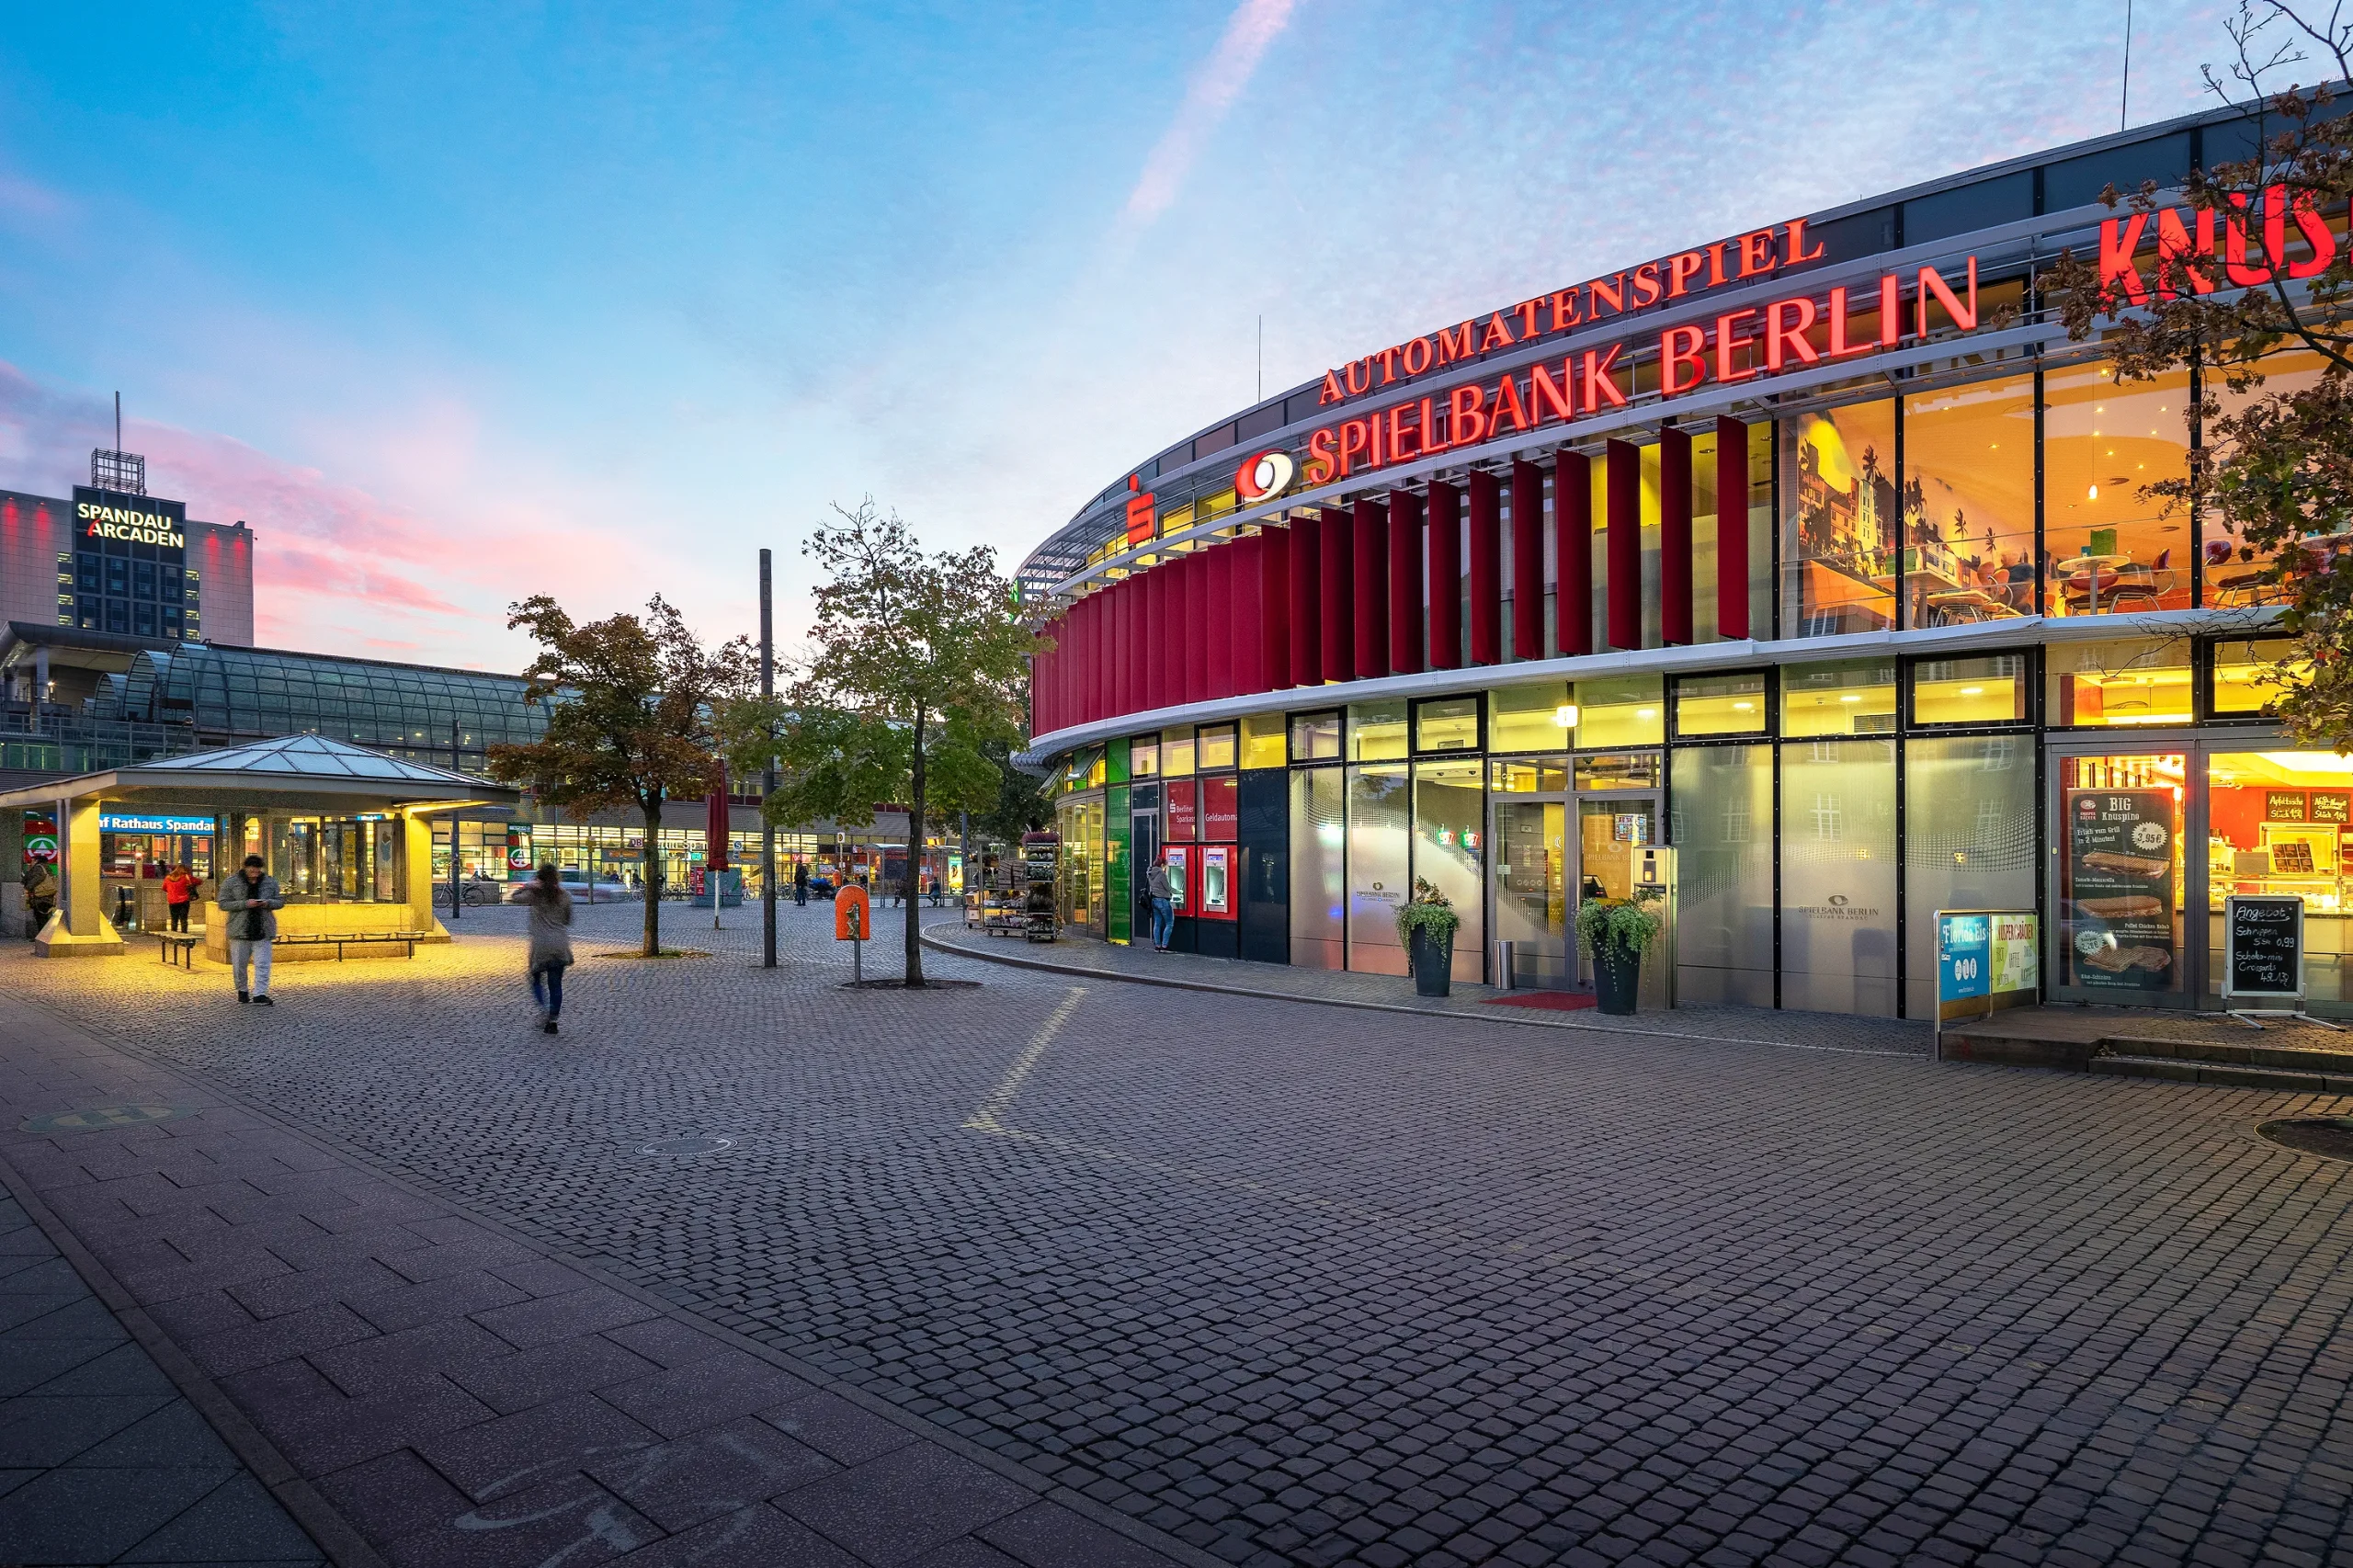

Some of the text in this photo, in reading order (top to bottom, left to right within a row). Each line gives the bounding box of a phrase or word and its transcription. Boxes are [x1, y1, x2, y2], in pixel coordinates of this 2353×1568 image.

[1318, 218, 1826, 407] AUTOMATENSPIEL
[1308, 255, 1979, 484] SPIELBANK BERLIN
[77, 503, 172, 530] SPANDAU
[86, 518, 184, 549] ARCADEN
[2109, 797, 2132, 811] BIG
[112, 817, 164, 830] Rathaus
[2102, 812, 2140, 823] Knuspino
[2108, 825, 2120, 834] Grill
[2137, 832, 2163, 845] 3,95€
[1798, 905, 1880, 916] SPIELBANK BERLIN
[2235, 905, 2286, 922] Angebot
[1943, 922, 1986, 944] Florida Eis
[2235, 926, 2279, 937] Schrippen
